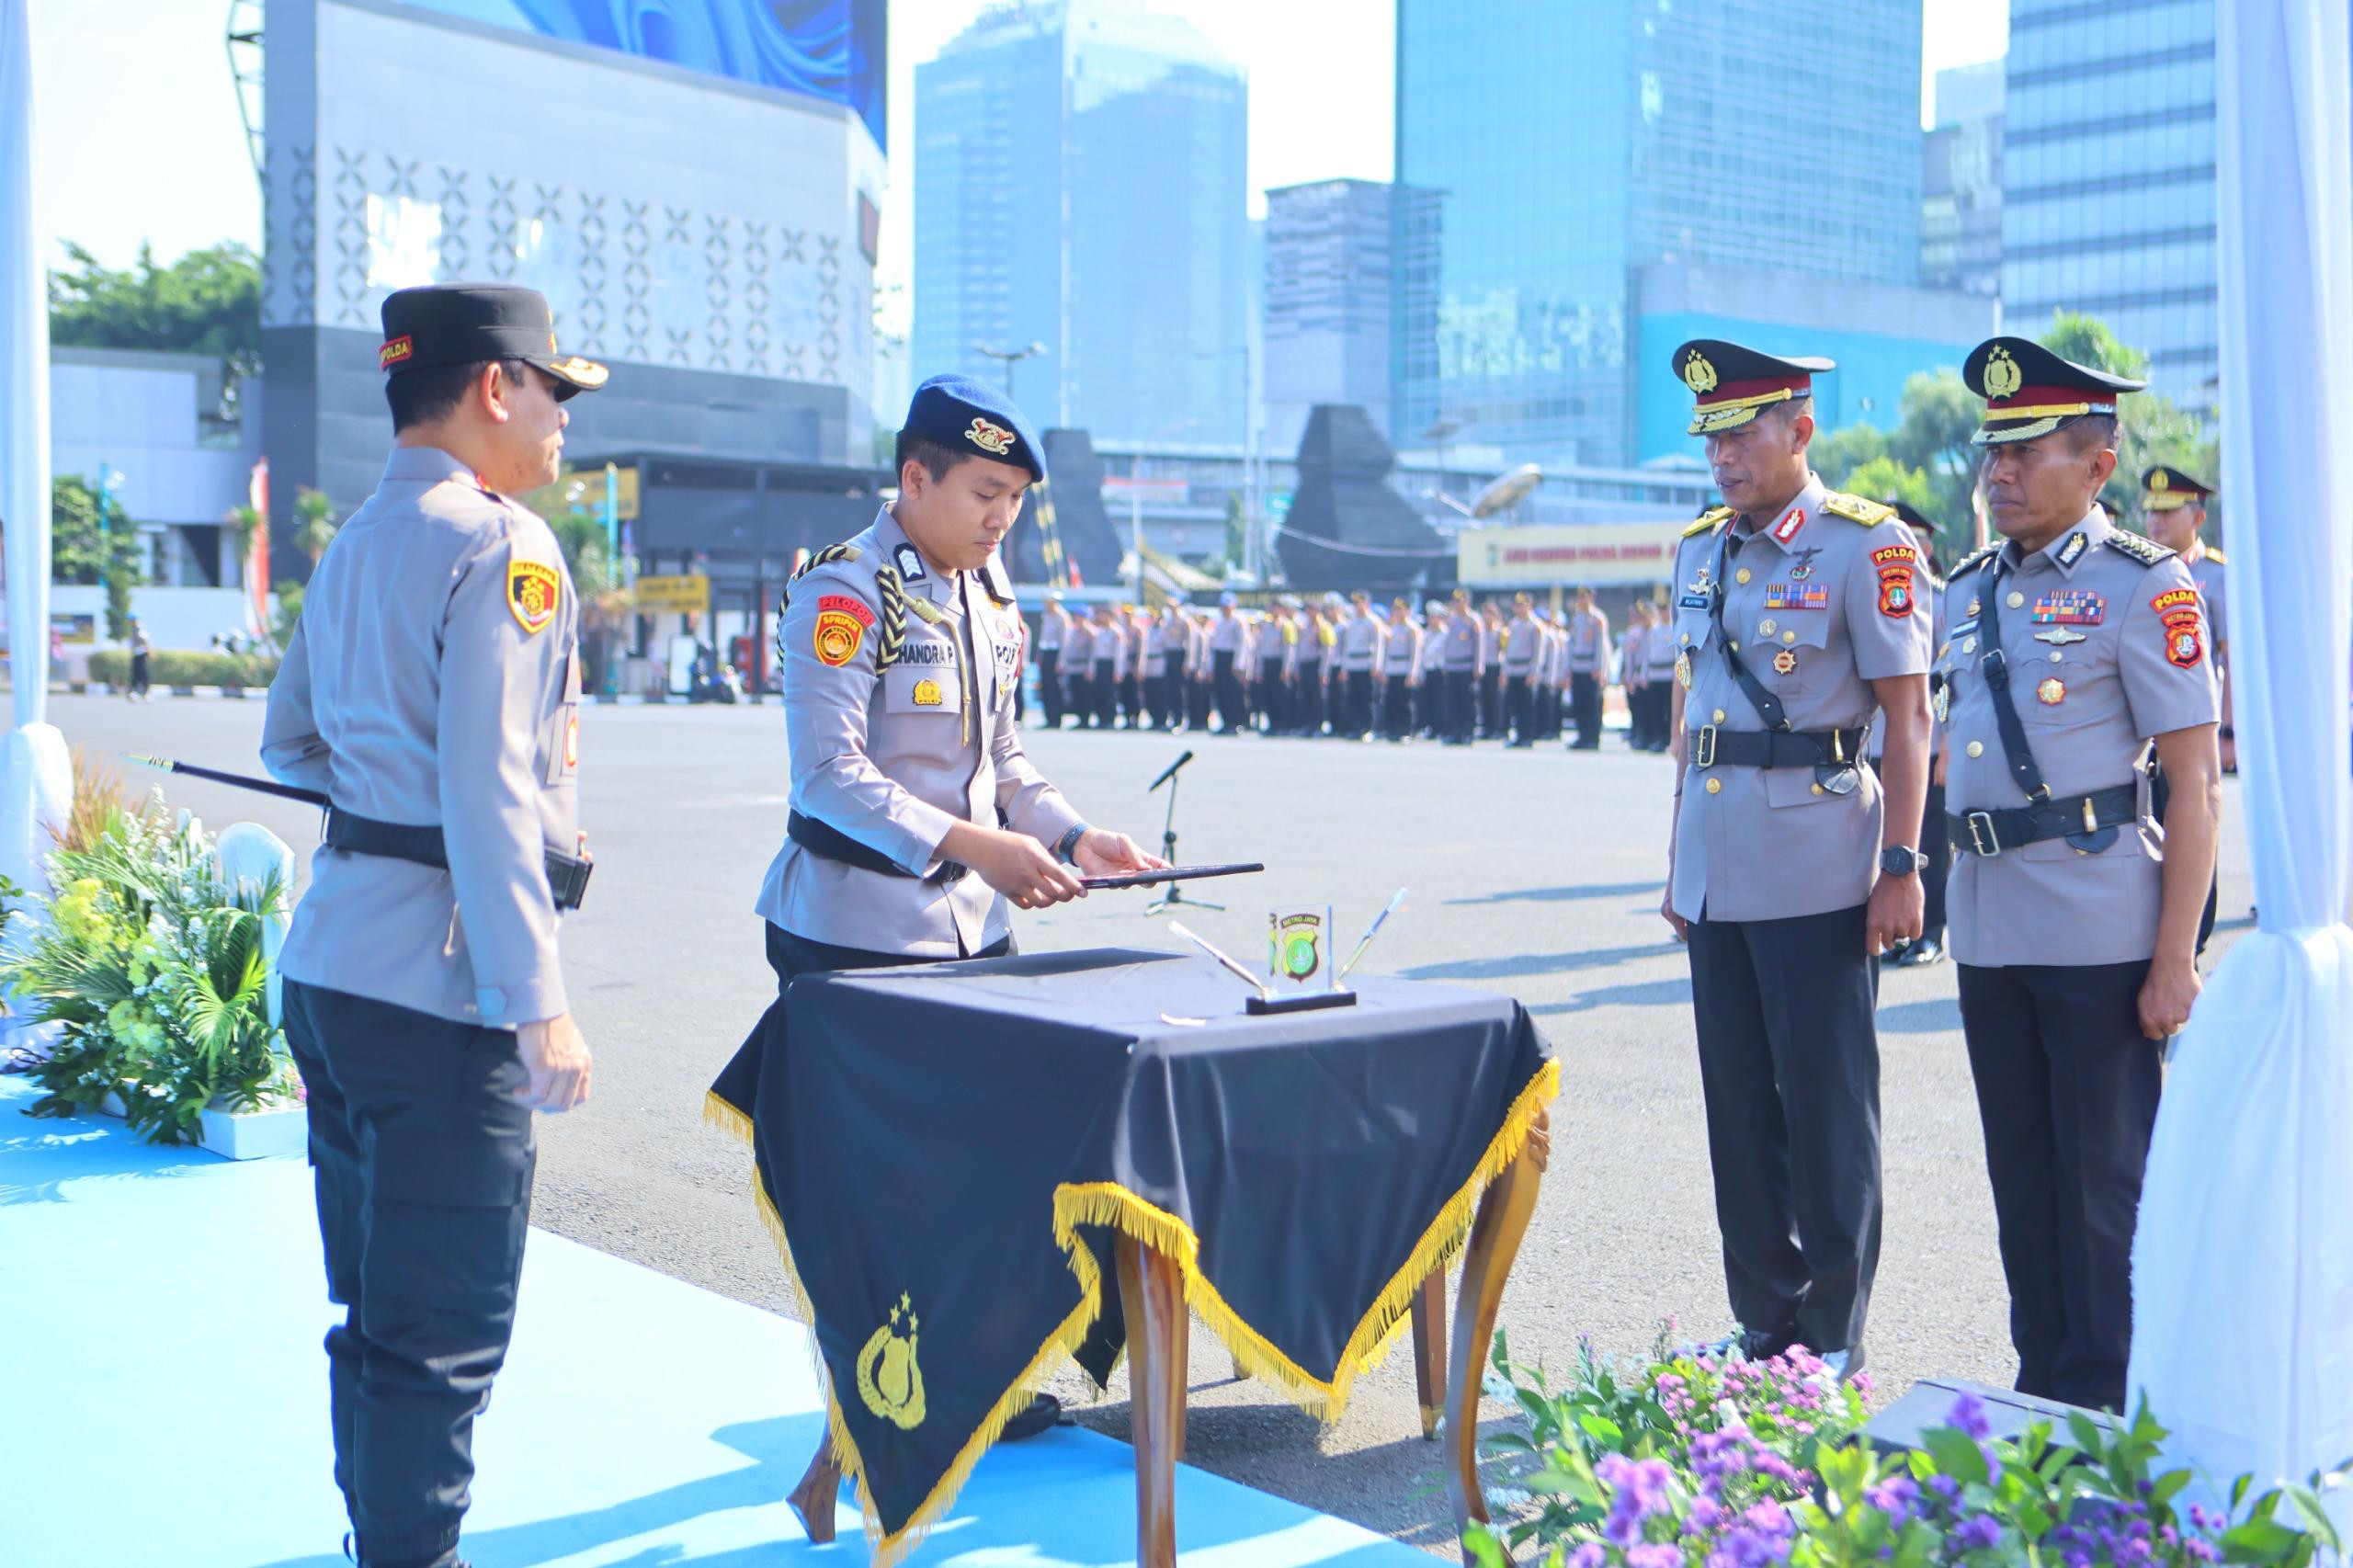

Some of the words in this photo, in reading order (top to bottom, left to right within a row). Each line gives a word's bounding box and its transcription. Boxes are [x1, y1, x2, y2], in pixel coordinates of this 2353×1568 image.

[1875, 548, 1915, 562] POLDA
[2154, 591, 2195, 609] POLDA
[821, 597, 874, 625] PELOPOR
[823, 616, 859, 632] SPRIPIM
[947, 645, 953, 663] P
[1282, 915, 1303, 926] METRO
[1303, 915, 1317, 925] JAYA
